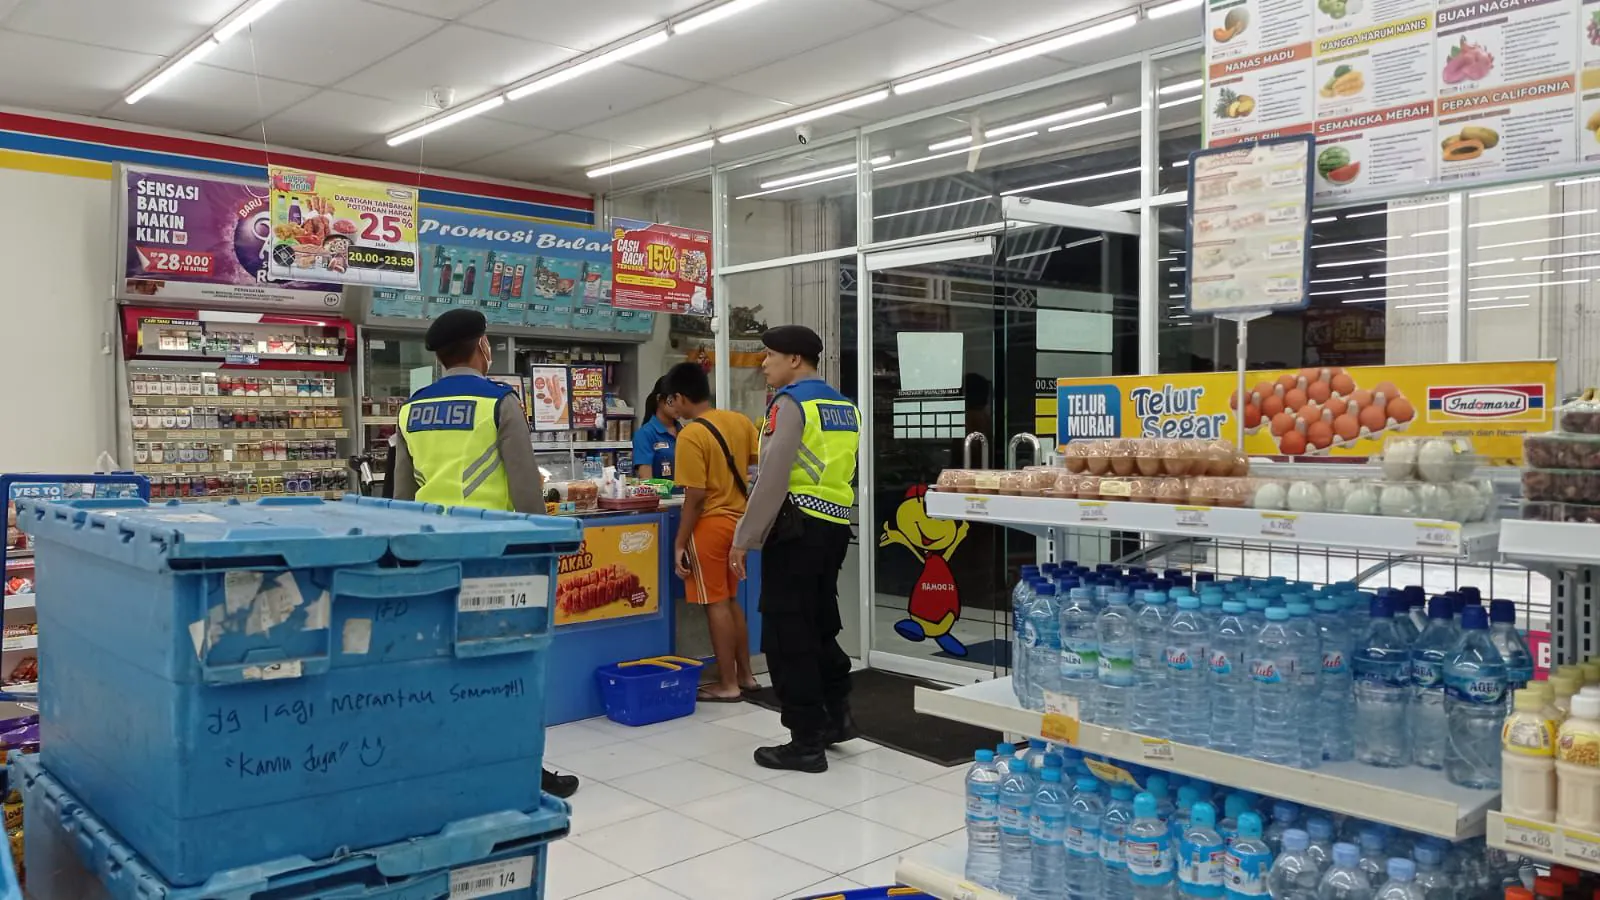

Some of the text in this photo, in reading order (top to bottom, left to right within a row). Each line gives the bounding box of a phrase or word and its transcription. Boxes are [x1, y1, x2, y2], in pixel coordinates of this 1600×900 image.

[1439, 7, 1476, 24] BUAH
[1320, 35, 1359, 51] MANGGA
[1359, 27, 1395, 43] HARUM
[1396, 18, 1428, 34] MANIS
[1225, 49, 1296, 73] NANAS MADU
[1441, 80, 1571, 113] PEPAYA CALIFORNIA
[1319, 113, 1383, 133] SEMANGKA
[1386, 104, 1431, 121] MERAH
[136, 180, 199, 201] SENSASI
[137, 195, 179, 214] BARU
[239, 197, 263, 218] BARU
[334, 194, 413, 212] DAPATKAN TAMBAHAN
[347, 203, 413, 218] POTONGAN HARGA
[137, 211, 185, 230] MAKIN
[136, 228, 170, 244] KLIK
[418, 218, 534, 244] Promosi
[617, 239, 640, 253] CASH
[622, 251, 645, 266] BACK
[646, 244, 677, 274] 15%
[1067, 394, 1106, 415] TELUR
[1132, 385, 1203, 416] Telur
[1448, 398, 1521, 410] Indomaret
[408, 405, 473, 427] POLISI
[1068, 415, 1115, 437] MURAH
[1143, 415, 1226, 439] Segar
[13, 486, 60, 498] YES TO
[510, 593, 527, 607] 1/4
[1469, 681, 1501, 694] AQUA
[499, 872, 515, 888] 1/4
